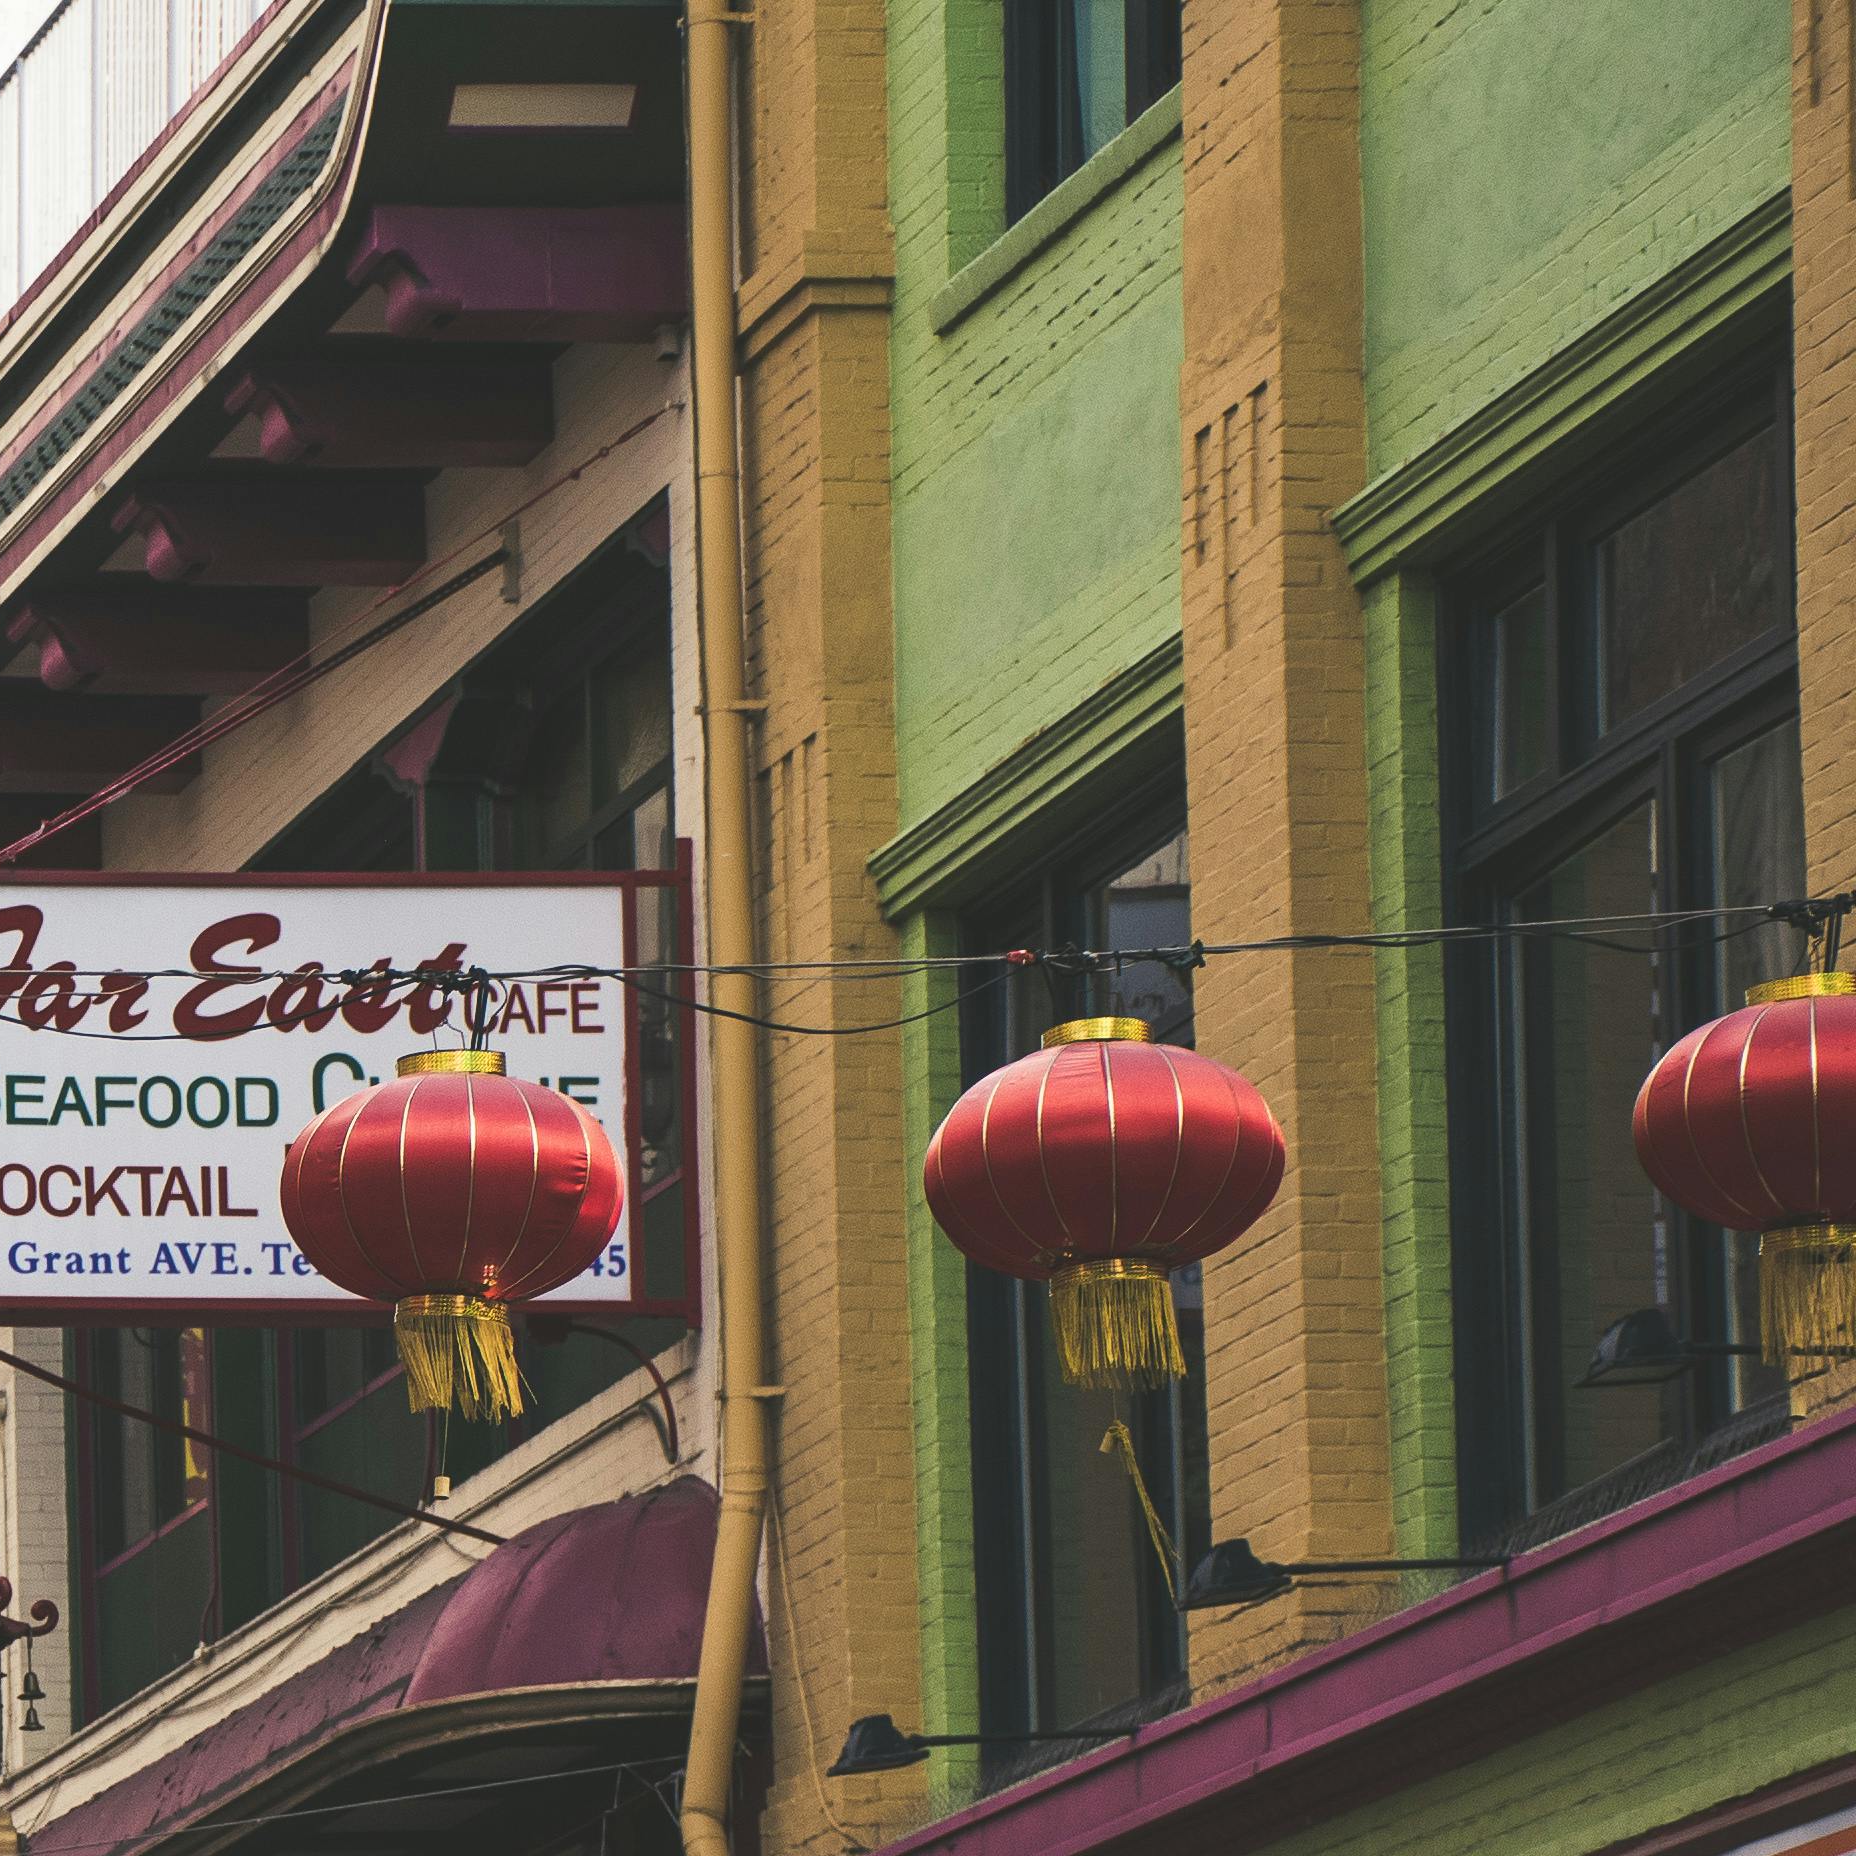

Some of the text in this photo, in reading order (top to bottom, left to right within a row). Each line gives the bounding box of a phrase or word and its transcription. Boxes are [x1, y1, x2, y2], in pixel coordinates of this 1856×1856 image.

[173, 912, 468, 1042] East
[8, 1241, 131, 1275] Grant
[149, 1241, 253, 1275] AVE.
